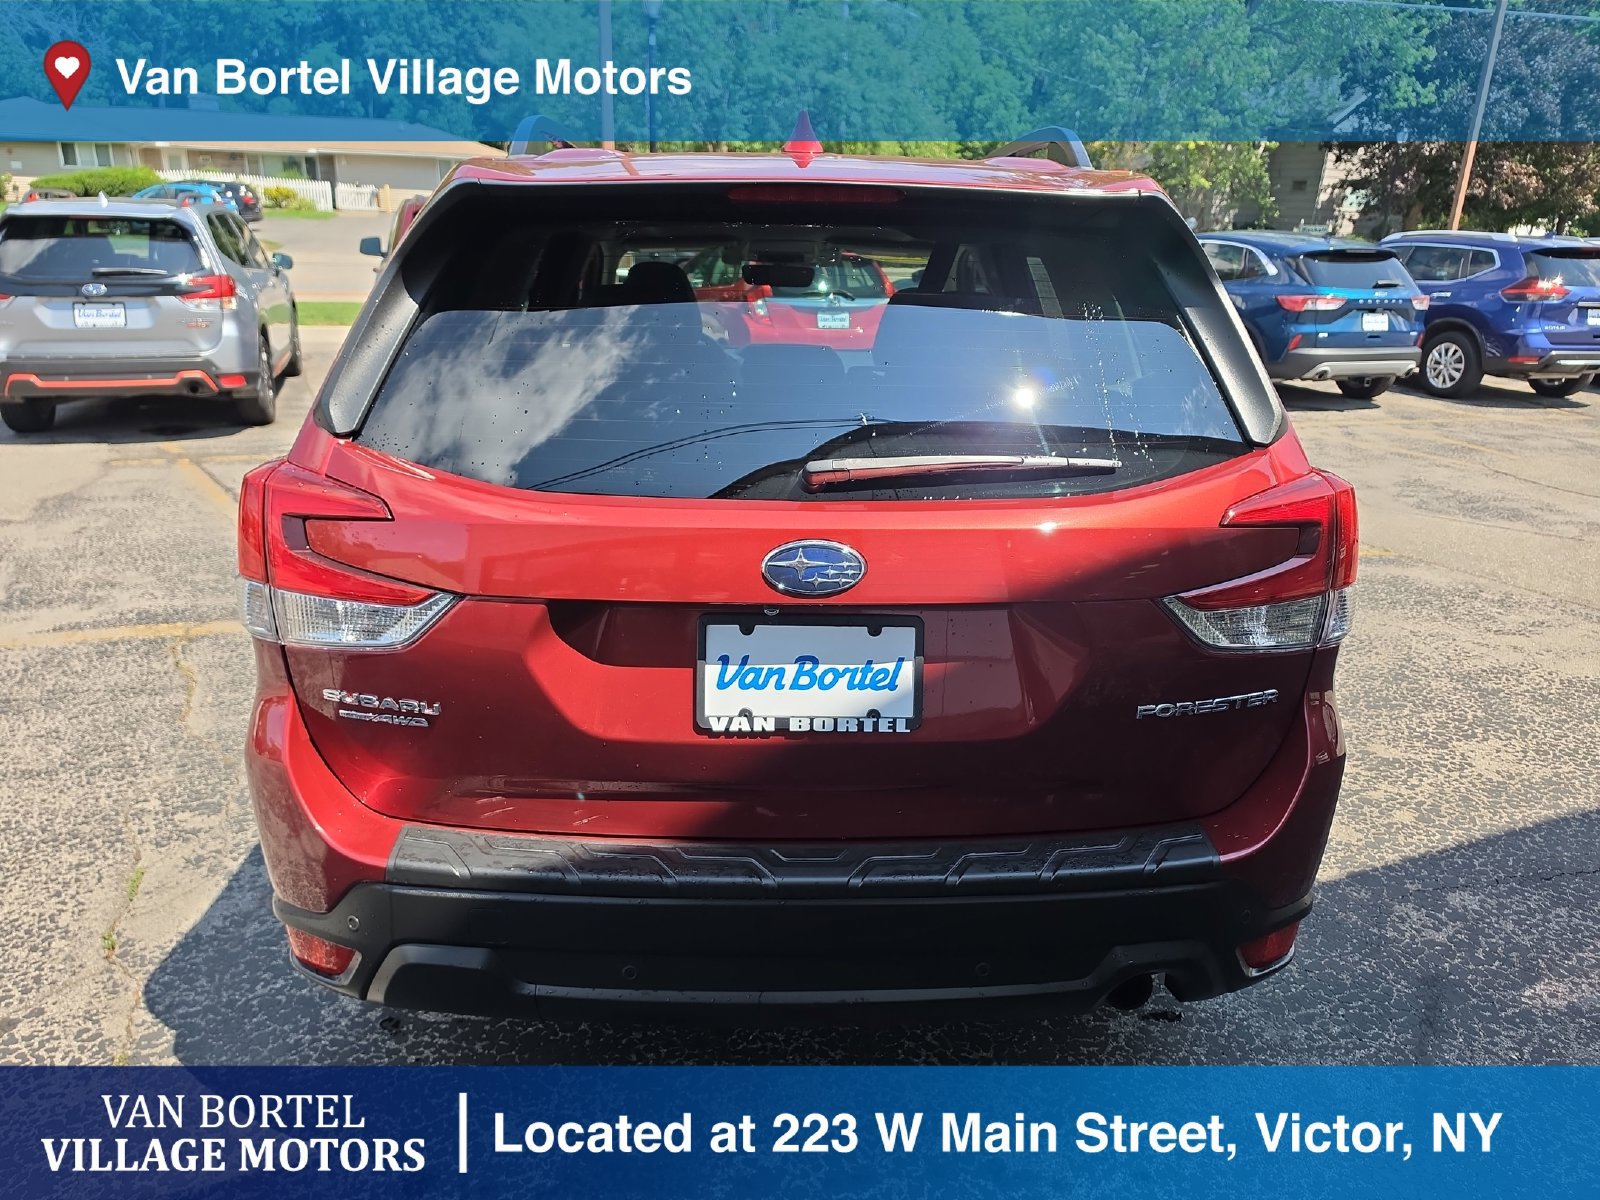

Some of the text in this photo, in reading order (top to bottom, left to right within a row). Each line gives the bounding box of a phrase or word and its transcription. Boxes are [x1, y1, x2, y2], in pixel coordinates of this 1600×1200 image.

[717, 654, 905, 691] Van Bortel
[322, 688, 441, 715] SUBARU
[1136, 688, 1279, 720] FORESTER
[708, 716, 911, 733] VAN BORTEL
